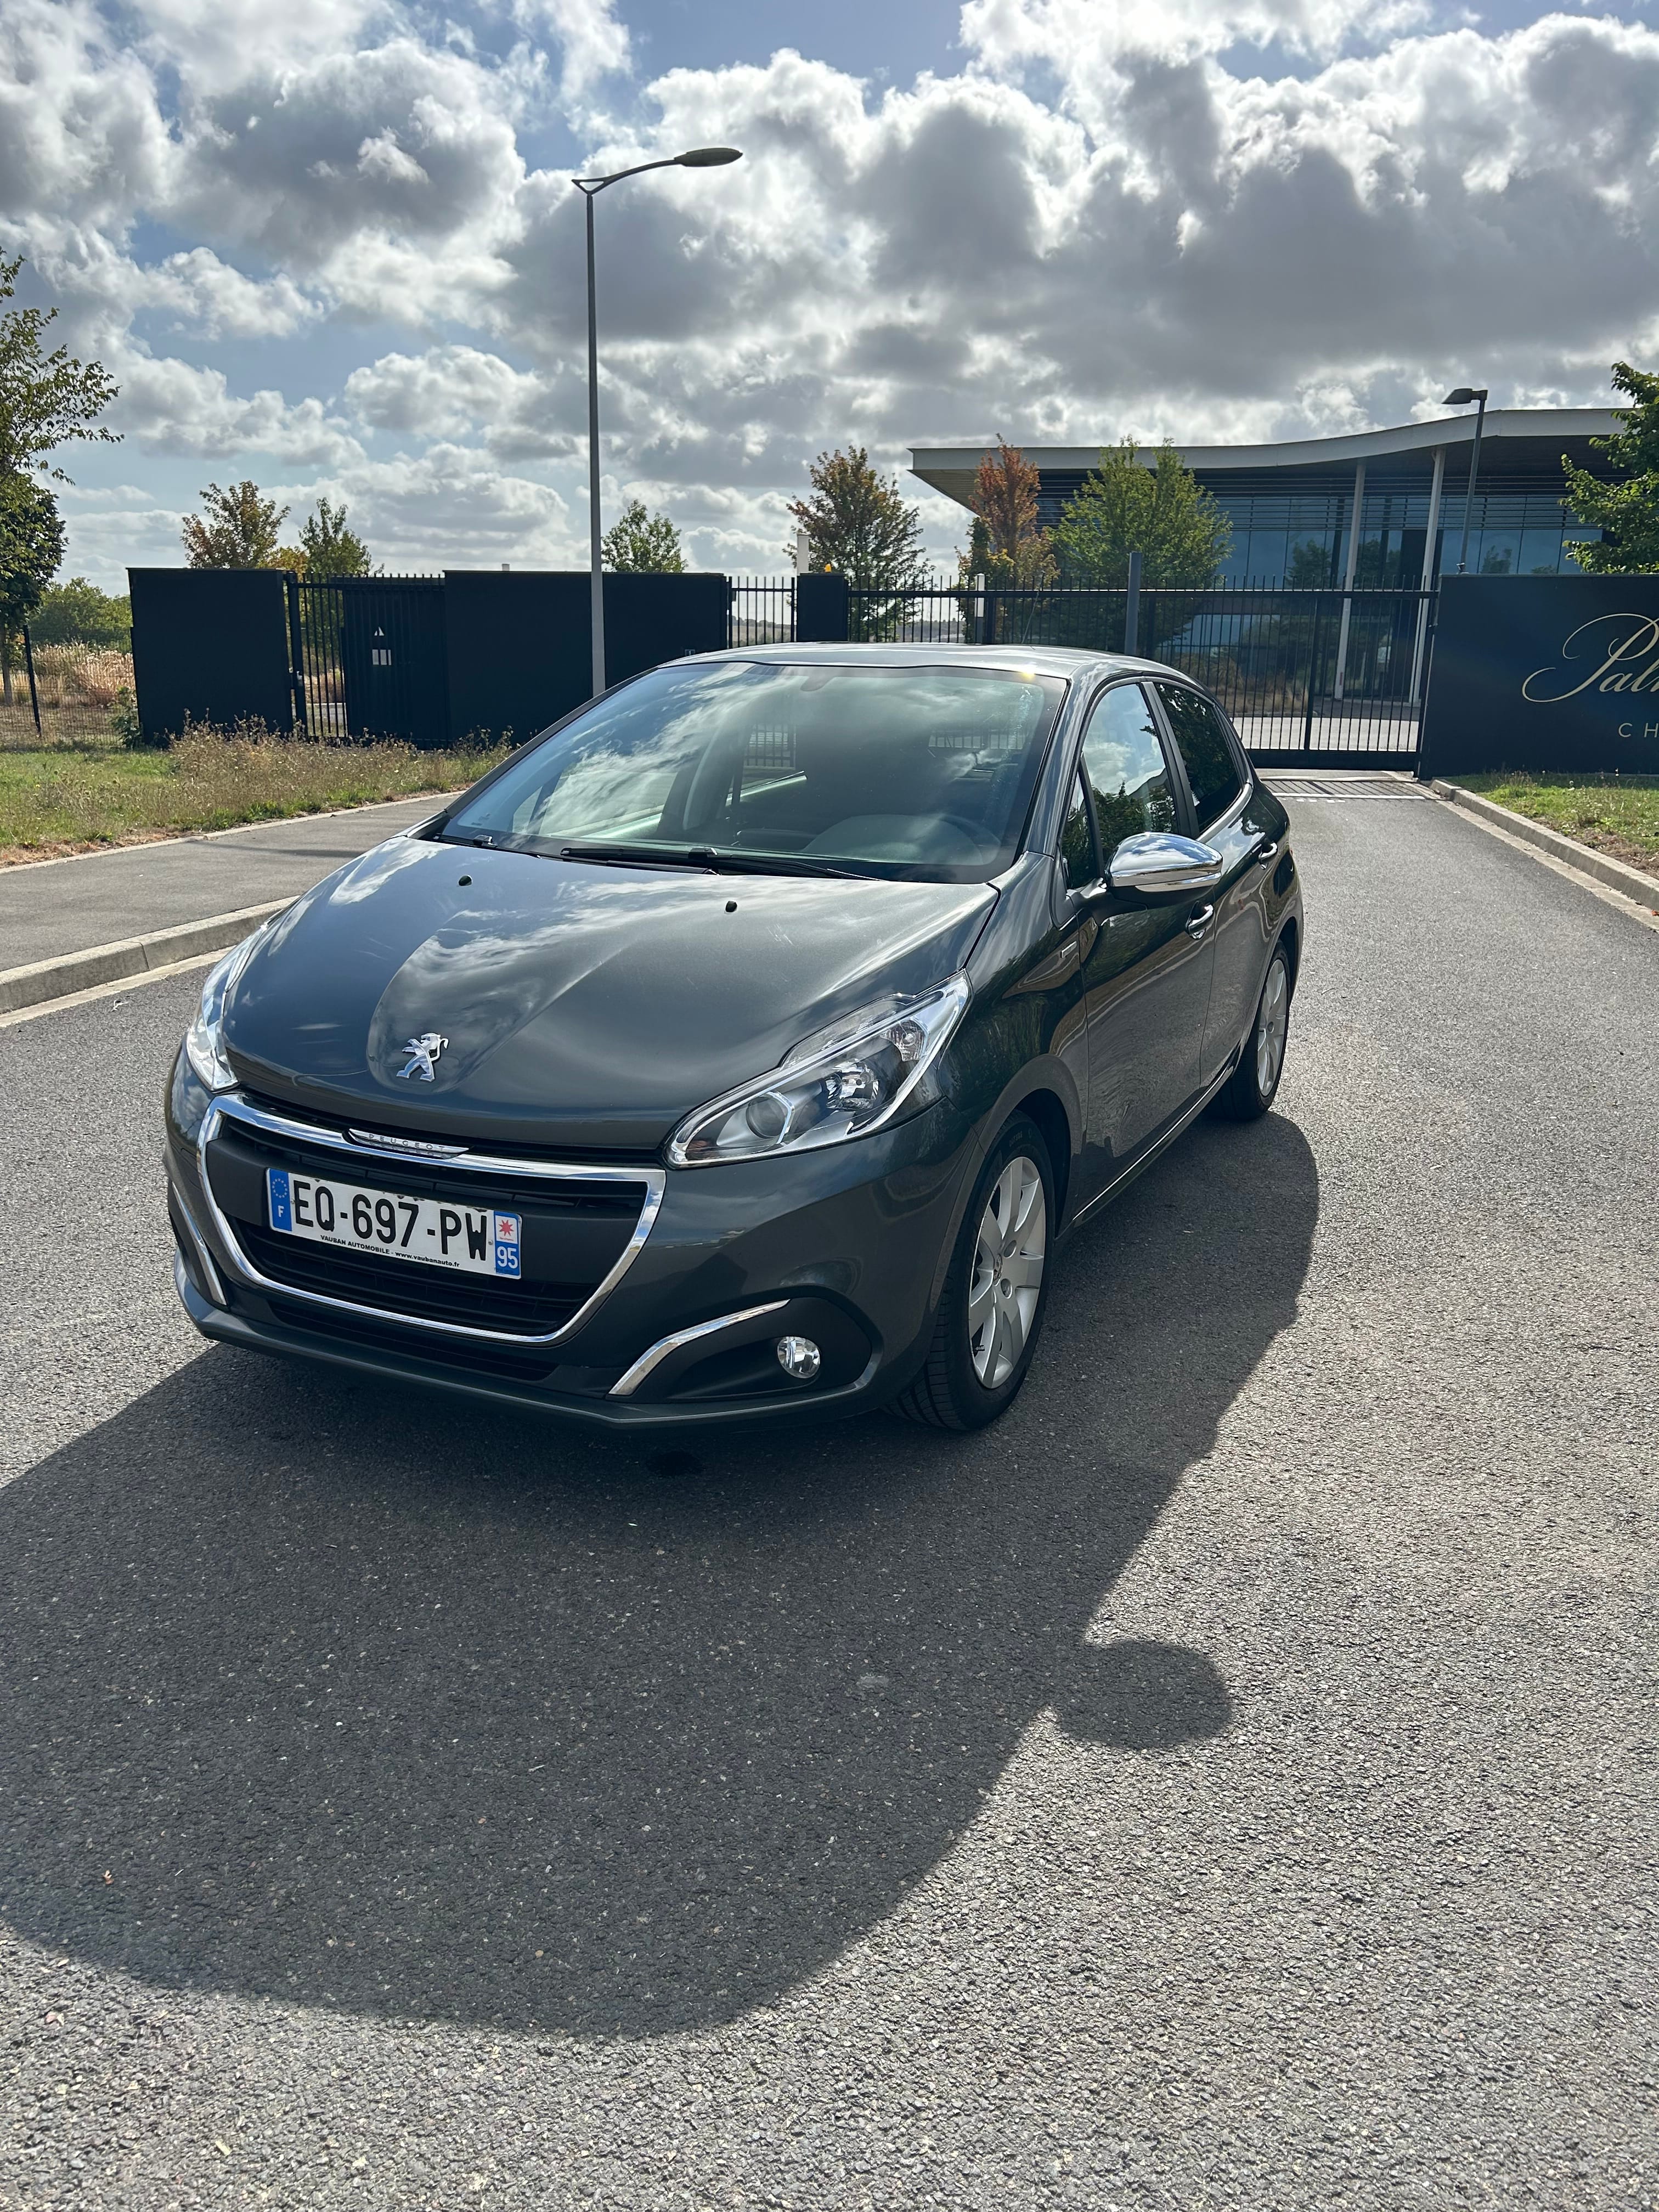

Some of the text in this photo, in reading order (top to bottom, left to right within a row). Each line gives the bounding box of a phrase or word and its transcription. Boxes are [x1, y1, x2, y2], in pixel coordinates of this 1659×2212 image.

[369, 1133, 445, 1152] PEUGEOT
[278, 1205, 285, 1218] F
[293, 1180, 487, 1261] EQ-697-PW
[320, 1234, 346, 1245] VAUBAN
[347, 1241, 390, 1255] AUTOMOBILE
[395, 1251, 460, 1268] www.vaubanauto.fr
[496, 1245, 518, 1269] 95
